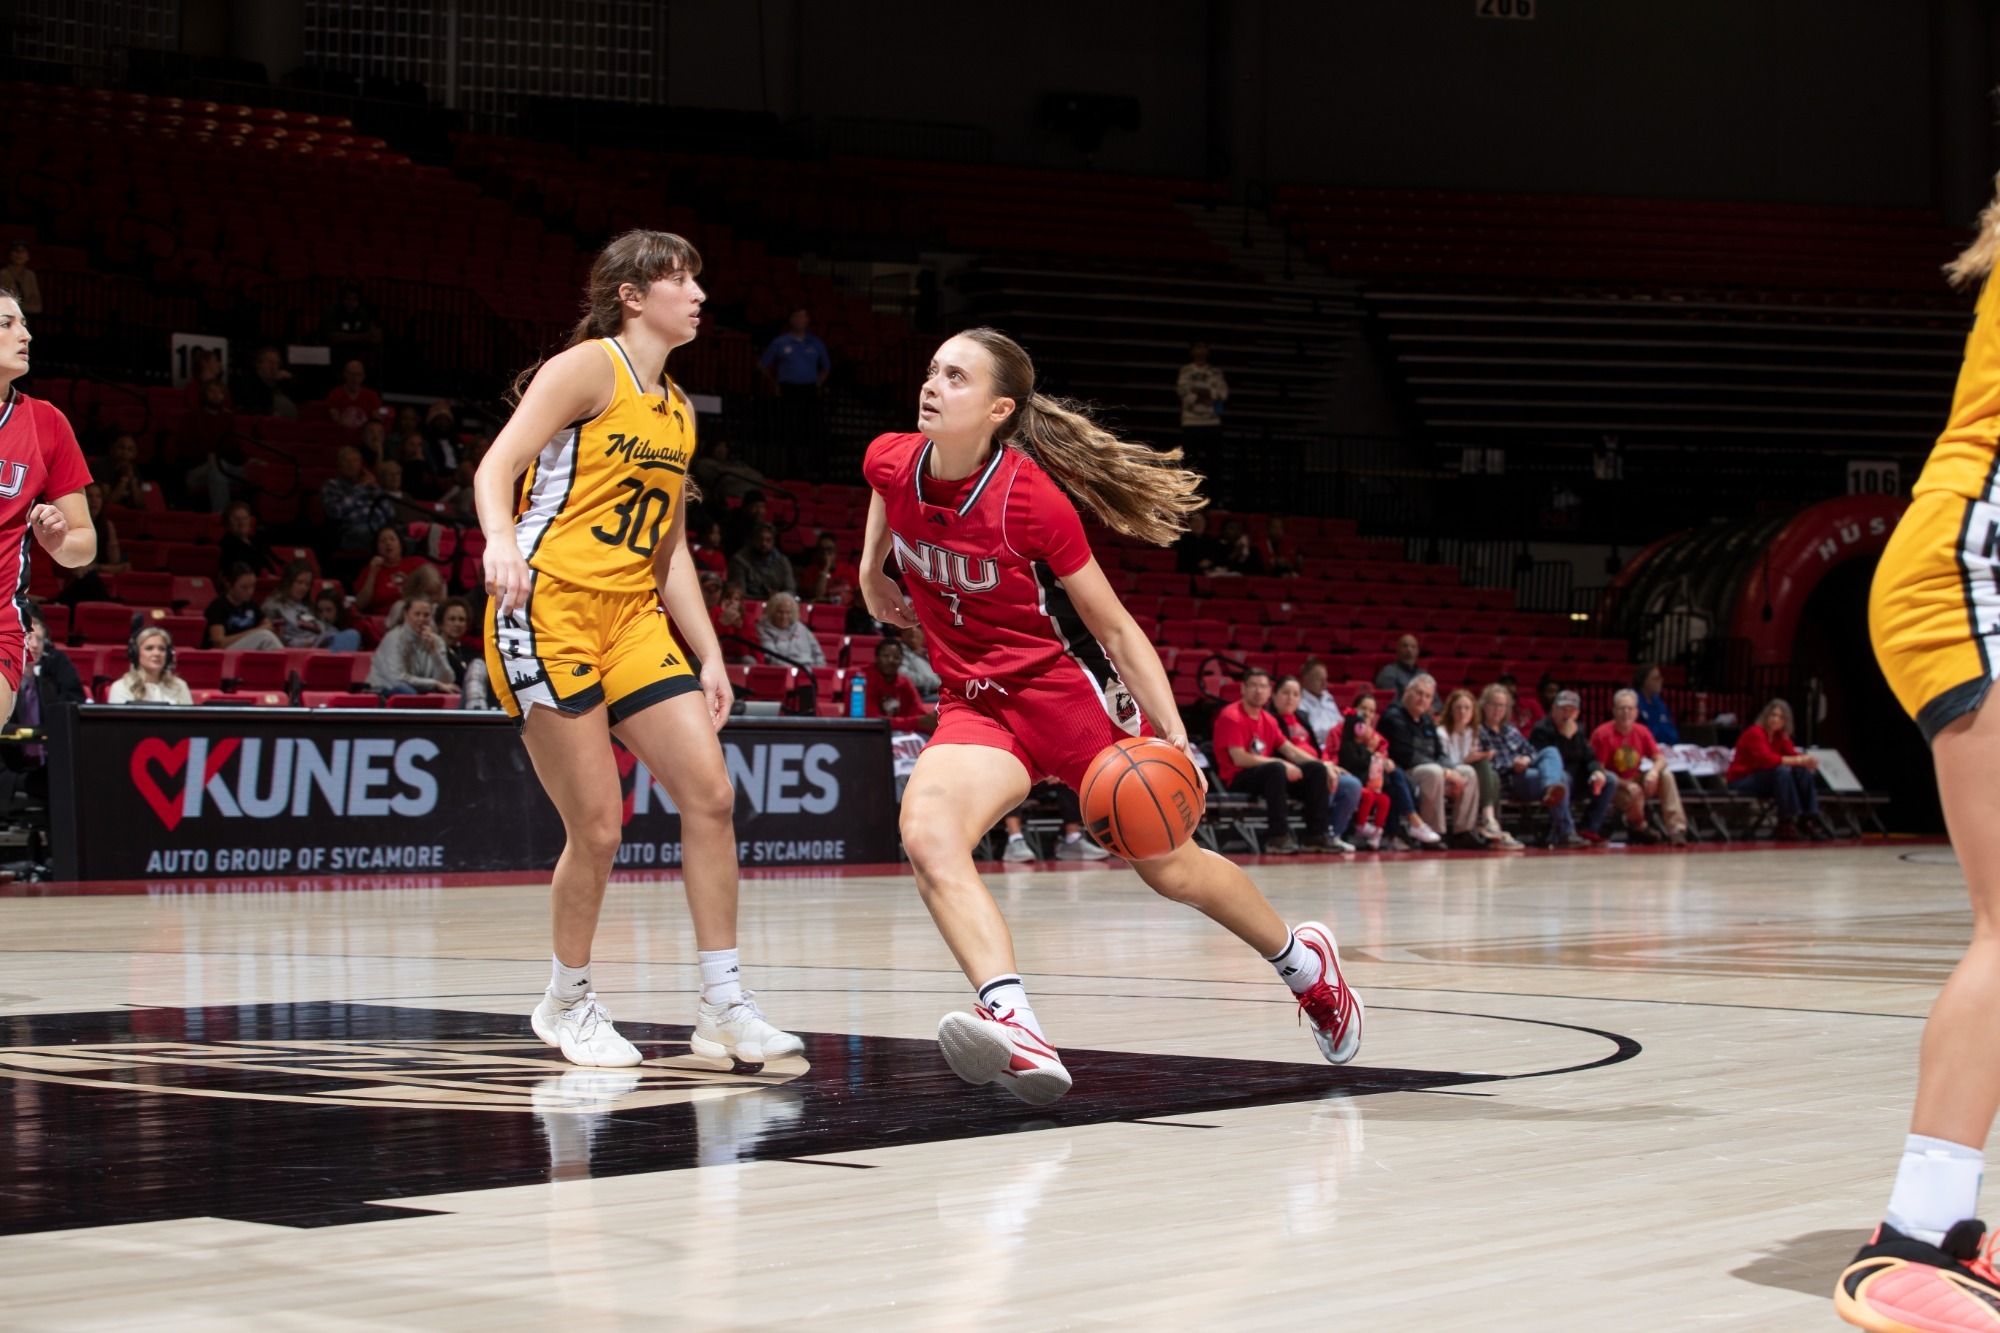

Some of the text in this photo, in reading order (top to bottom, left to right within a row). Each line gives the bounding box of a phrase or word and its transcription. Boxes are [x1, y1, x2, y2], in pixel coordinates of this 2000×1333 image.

[1852, 469, 1896, 494] 106
[590, 476, 670, 559] 30
[890, 528, 1000, 593] NIU
[181, 737, 441, 818] KUNES
[632, 742, 842, 815] KNES
[146, 845, 444, 873] AUTO GROUP OF SYCAMORE
[752, 840, 846, 861] SYCAMORE
